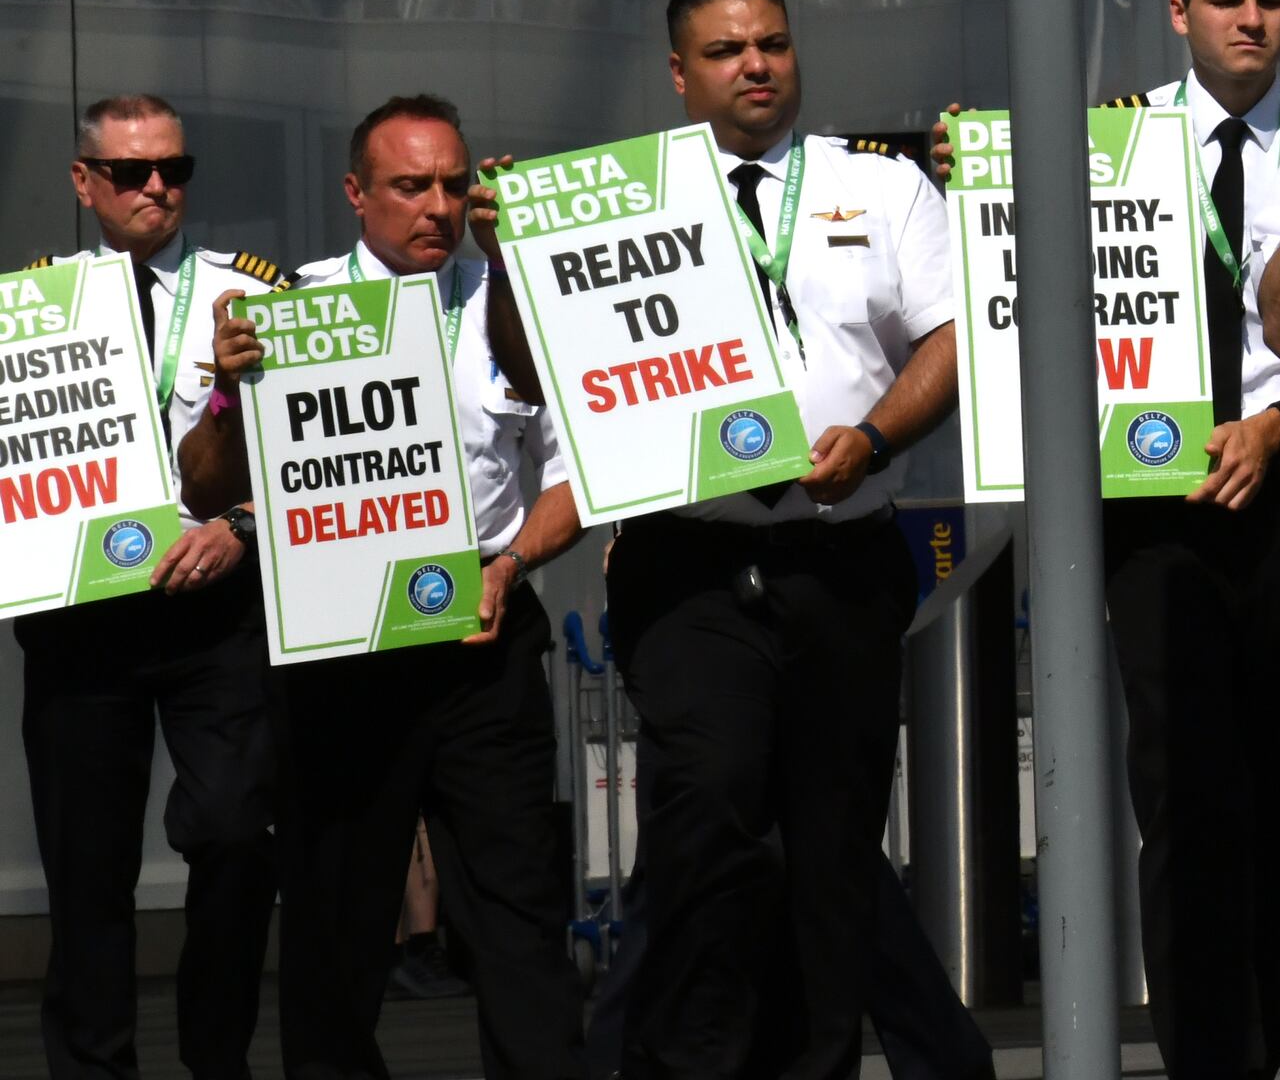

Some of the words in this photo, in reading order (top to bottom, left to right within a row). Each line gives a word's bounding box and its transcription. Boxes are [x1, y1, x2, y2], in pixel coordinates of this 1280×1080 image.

[498, 154, 627, 204] DELTA
[787, 184, 797, 195] TO
[791, 157, 800, 178] NEW
[507, 182, 653, 237] PILOTS
[780, 213, 793, 236] HATS
[784, 194, 795, 213] OFF
[981, 199, 1173, 236] INTRY-
[550, 224, 704, 295] READY
[1003, 245, 1159, 282] LING
[176, 305, 185, 317] TO
[246, 294, 360, 334] DELTA
[614, 294, 678, 342] TO
[583, 340, 752, 412] STRIKE
[0, 378, 115, 426] EADING
[286, 377, 419, 441] PILOT
[726, 411, 755, 423] DELTA
[1138, 413, 1167, 423] DELTA
[281, 441, 442, 493] CONTRACT
[0, 458, 116, 522] NOW
[288, 490, 449, 545] DELAYED
